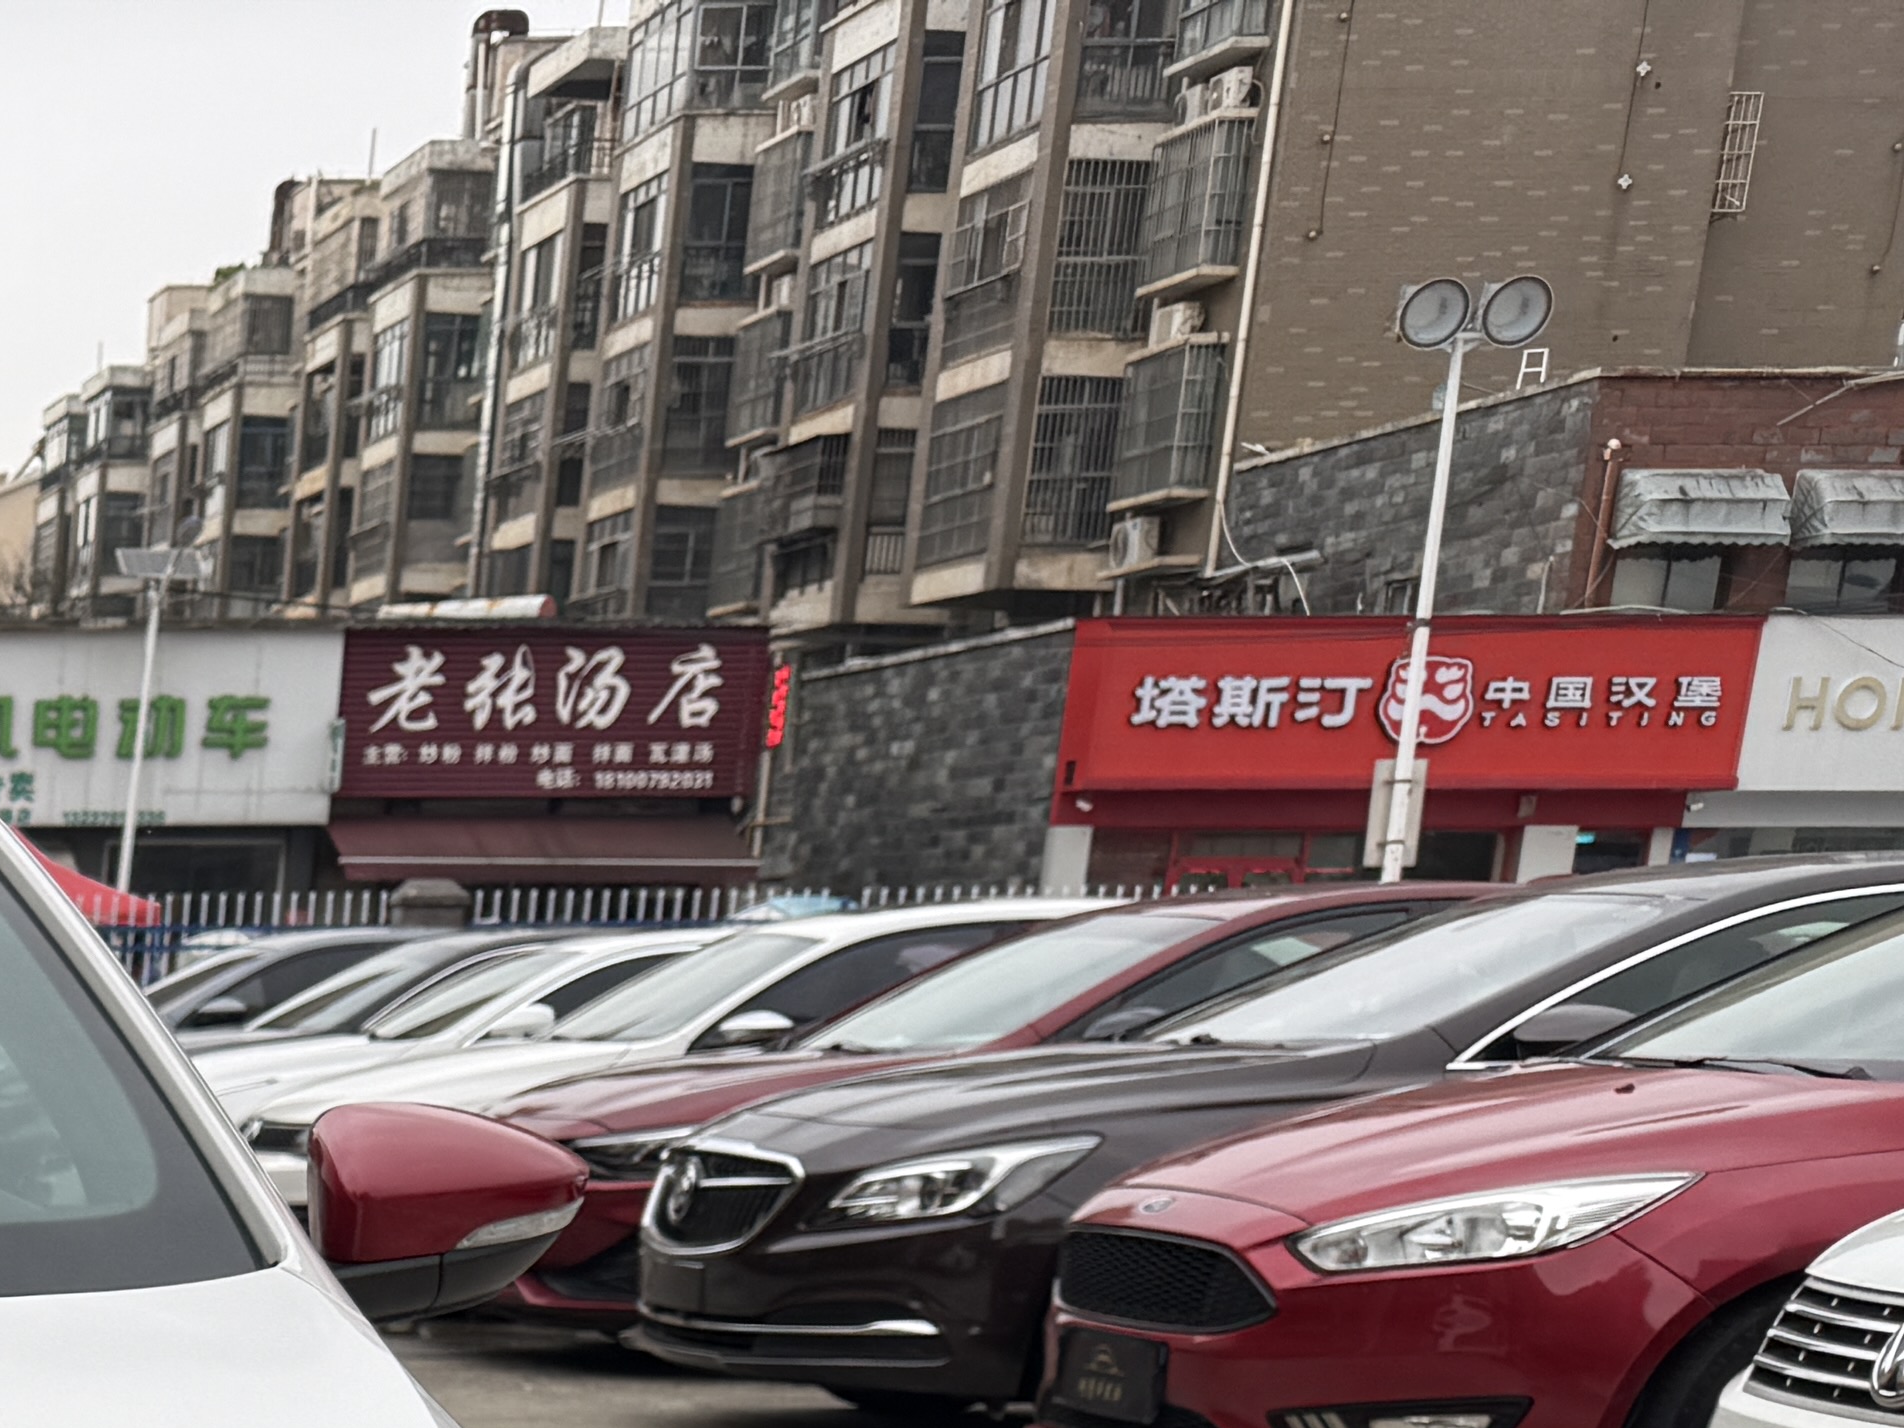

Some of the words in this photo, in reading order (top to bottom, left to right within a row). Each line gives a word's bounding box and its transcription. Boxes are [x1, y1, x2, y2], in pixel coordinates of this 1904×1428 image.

[368, 643, 724, 733] 老张汤店
[1130, 675, 1373, 729] 塔斯汀
[1484, 676, 1722, 709] 中国汉堡
[1782, 675, 1904, 732] HO
[1481, 711, 1717, 728] TASITING
